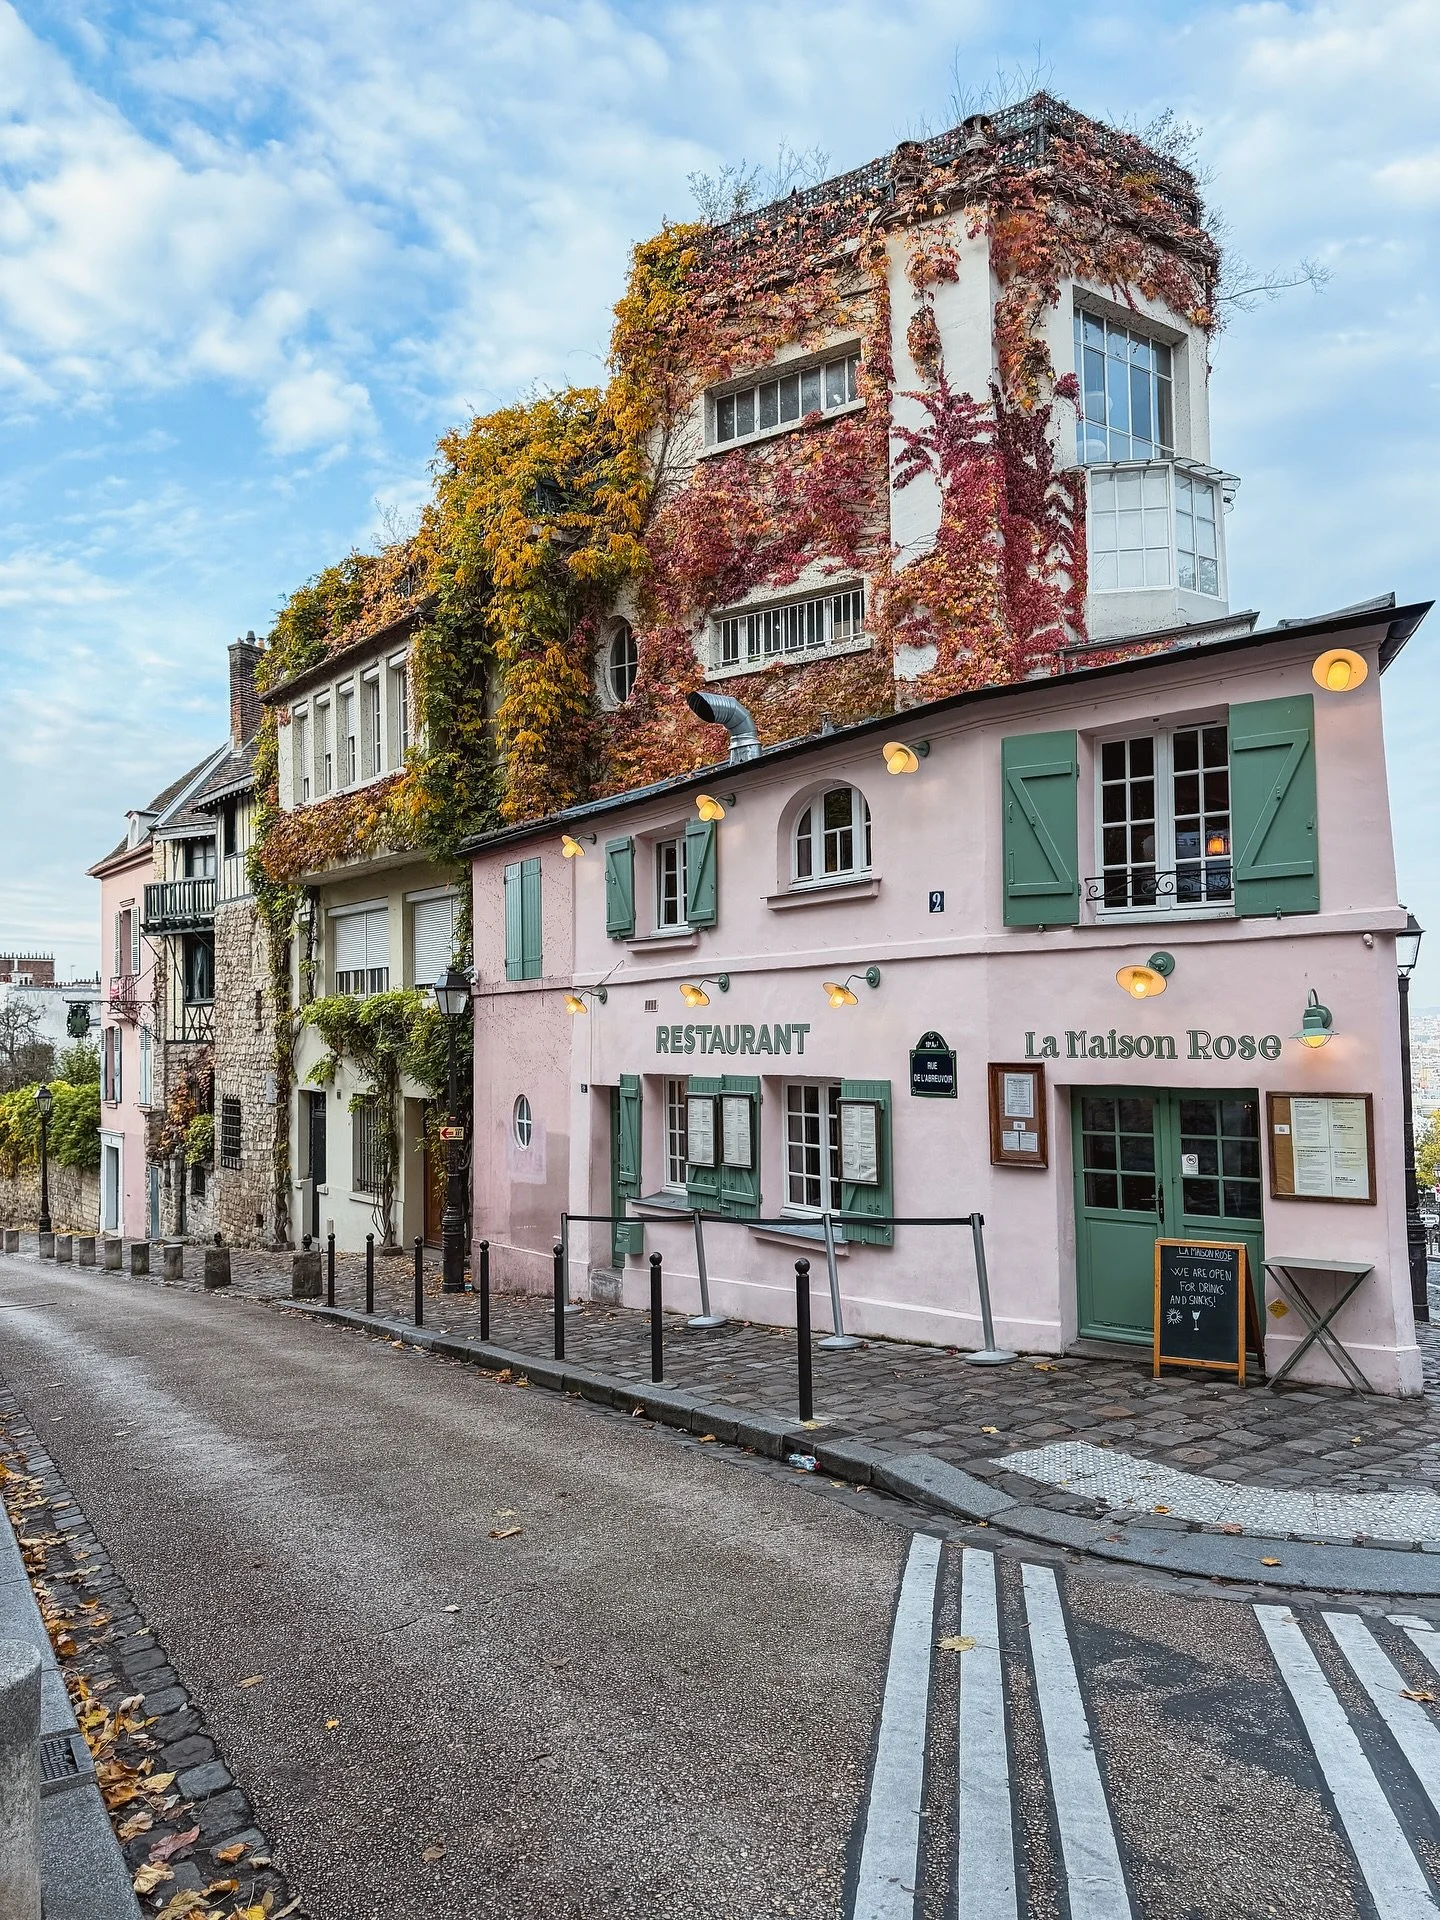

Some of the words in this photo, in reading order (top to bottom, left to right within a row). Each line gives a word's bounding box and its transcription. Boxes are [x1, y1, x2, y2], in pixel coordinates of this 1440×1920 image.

[932, 892, 941, 912] 2
[656, 1023, 811, 1055] RESTAURANT
[1024, 1031, 1060, 1059] La
[1065, 1029, 1178, 1059] Maison
[1186, 1029, 1282, 1060] Rose
[927, 1061, 938, 1070] RUE
[914, 1074, 920, 1082] DE
[921, 1074, 952, 1083] L'ABREUVOIR
[1190, 1248, 1214, 1257] MAISON
[1214, 1250, 1232, 1260] ROSE
[1170, 1268, 1190, 1276] WE
[1192, 1268, 1208, 1278] ARE
[1208, 1268, 1232, 1281] OPEN
[1180, 1281, 1196, 1292] FOR
[1170, 1295, 1187, 1304] AND
[1189, 1295, 1216, 1308] SNACKS!
